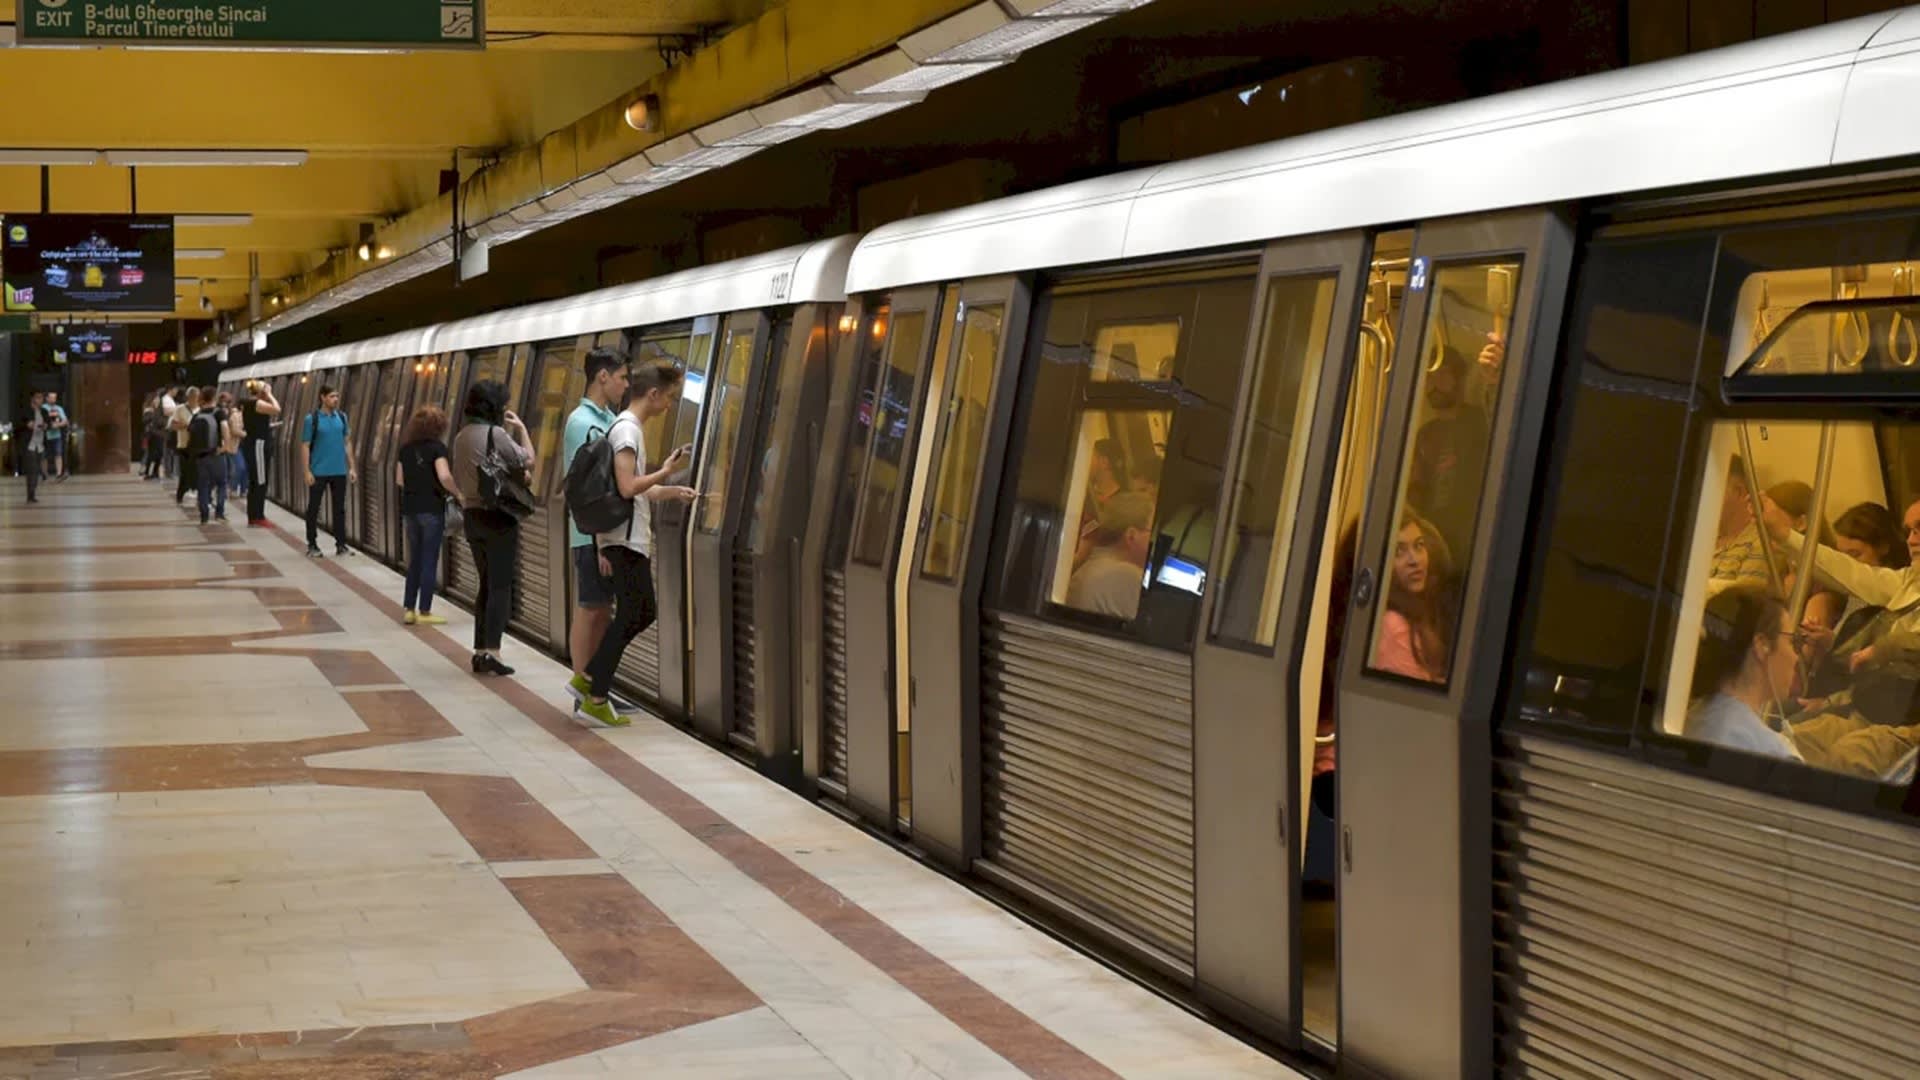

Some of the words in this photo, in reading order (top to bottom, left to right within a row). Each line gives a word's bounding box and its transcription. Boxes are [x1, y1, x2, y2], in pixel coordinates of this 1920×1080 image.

[36, 10, 73, 27] EXIT
[85, 3, 130, 20] B-dul
[135, 4, 214, 24] Gheorghe
[218, 6, 267, 22] Sincai
[85, 20, 140, 37] Parcul
[143, 20, 234, 38] Tineretului
